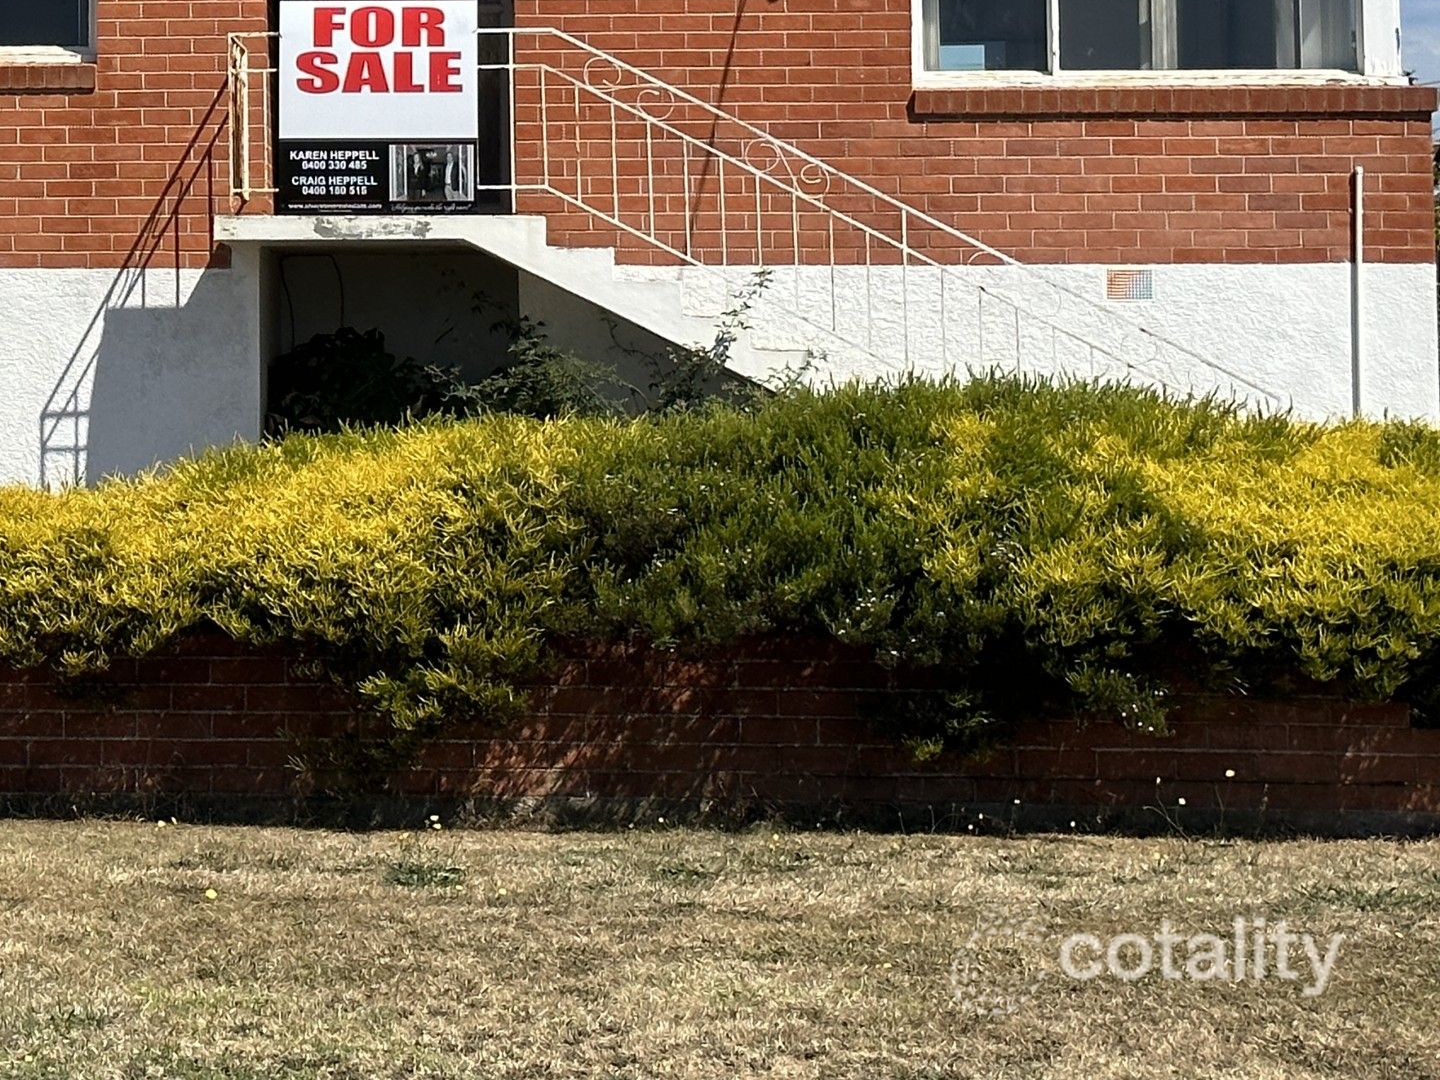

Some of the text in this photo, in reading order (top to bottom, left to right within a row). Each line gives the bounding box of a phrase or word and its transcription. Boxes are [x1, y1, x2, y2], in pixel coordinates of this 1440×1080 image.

[313, 6, 445, 48] FOR
[296, 51, 463, 94] SALE
[289, 150, 380, 160] KAREN HEPPELL
[301, 160, 326, 170] 0400
[328, 160, 347, 170] 330
[291, 175, 379, 186] CRAIG HEPPELL
[301, 185, 326, 195] 0400
